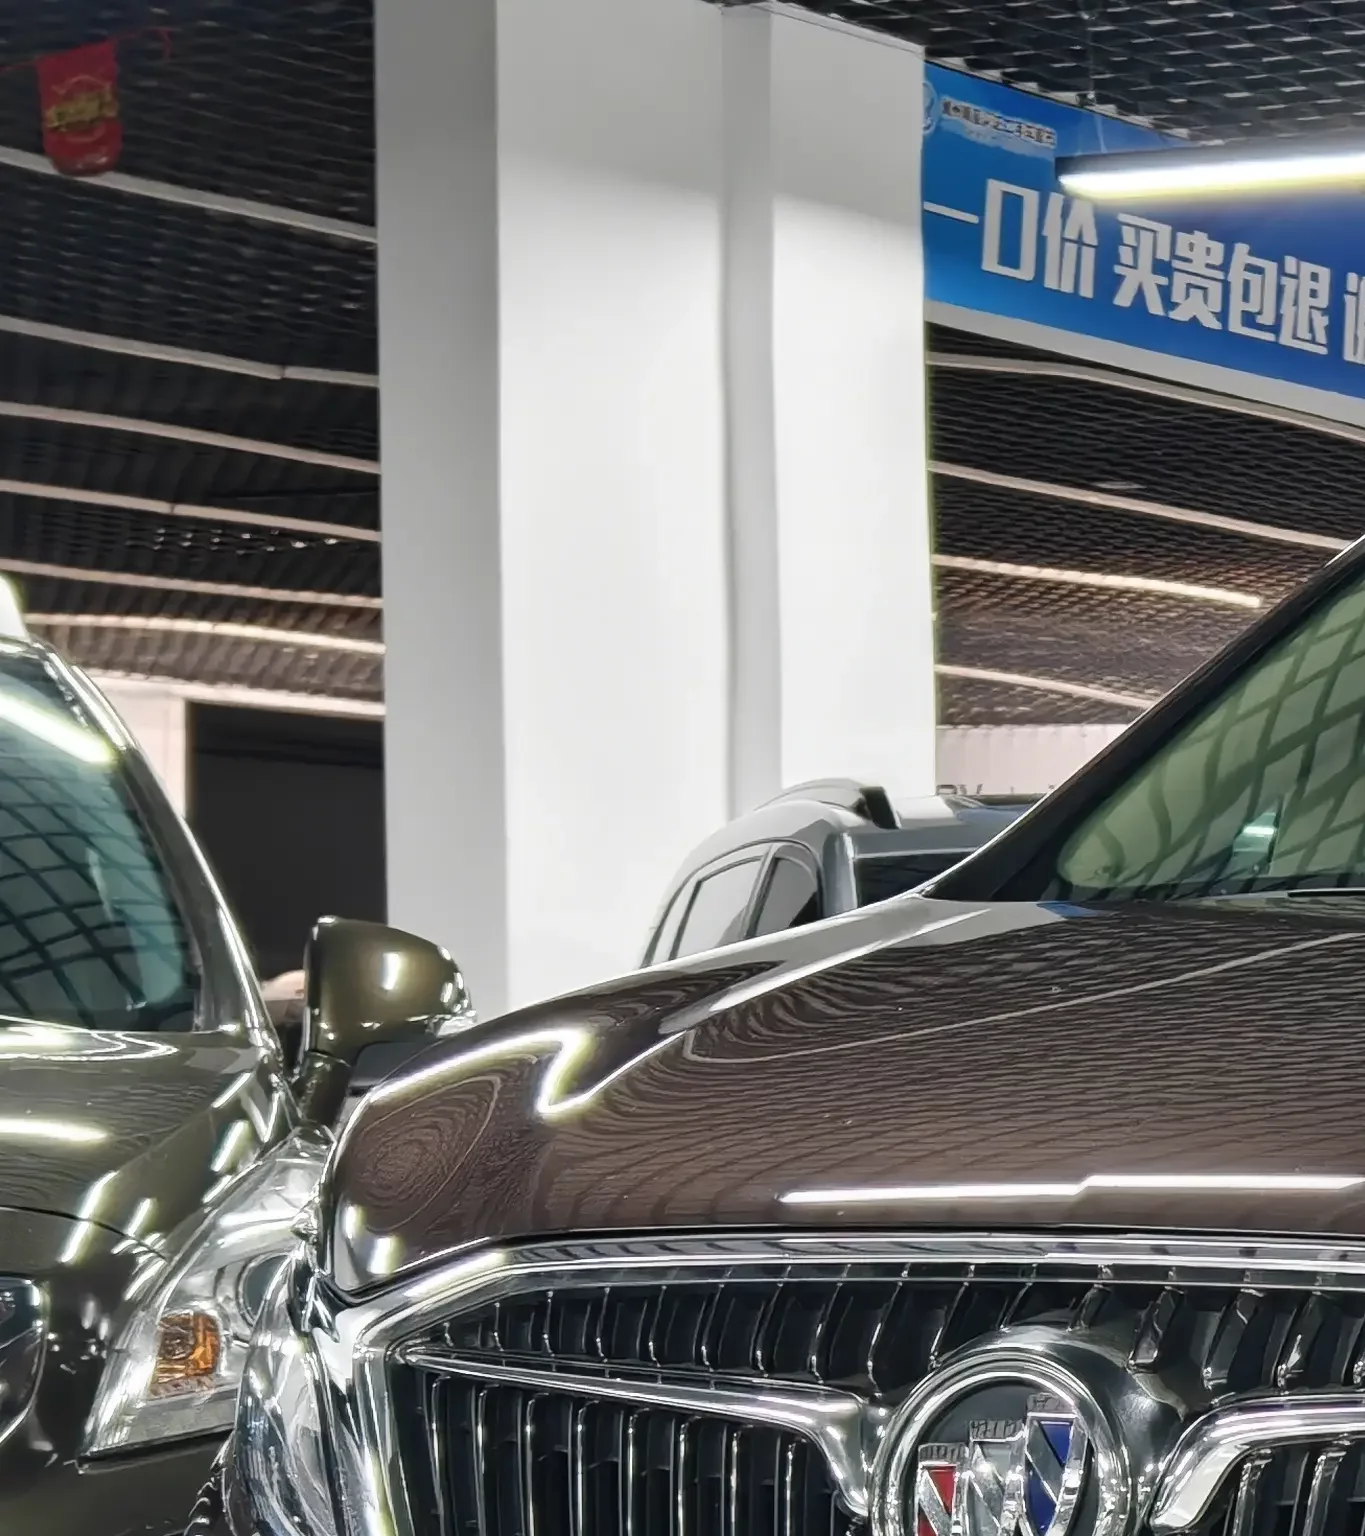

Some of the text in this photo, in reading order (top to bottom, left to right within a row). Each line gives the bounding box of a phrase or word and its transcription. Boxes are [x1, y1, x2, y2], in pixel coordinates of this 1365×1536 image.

[923, 178, 1098, 298] 一口价
[1113, 213, 1330, 354] 买贵包退
